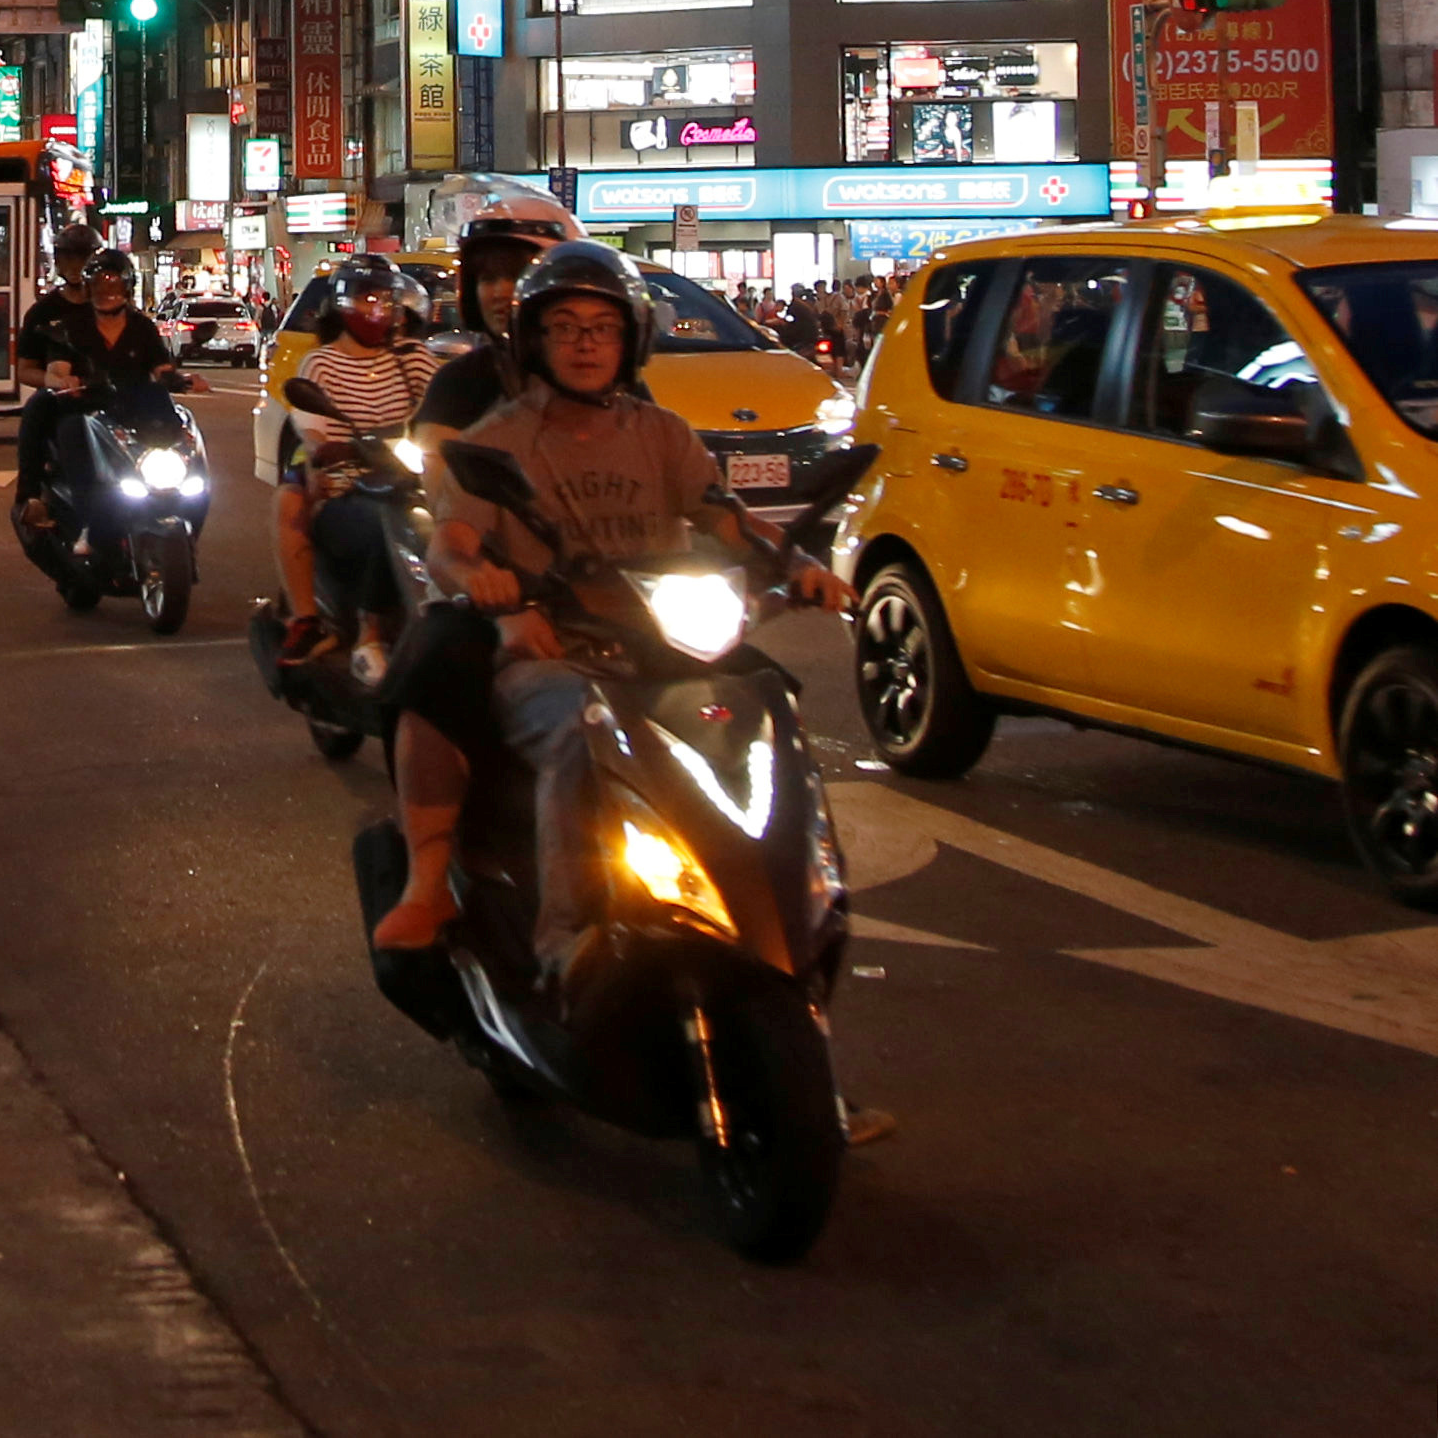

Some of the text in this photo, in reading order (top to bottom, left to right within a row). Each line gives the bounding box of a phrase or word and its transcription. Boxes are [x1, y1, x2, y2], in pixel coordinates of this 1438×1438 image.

[1122, 47, 1320, 83] (2)2375-5500
[601, 186, 688, 205] watsons
[838, 181, 946, 201] watsons
